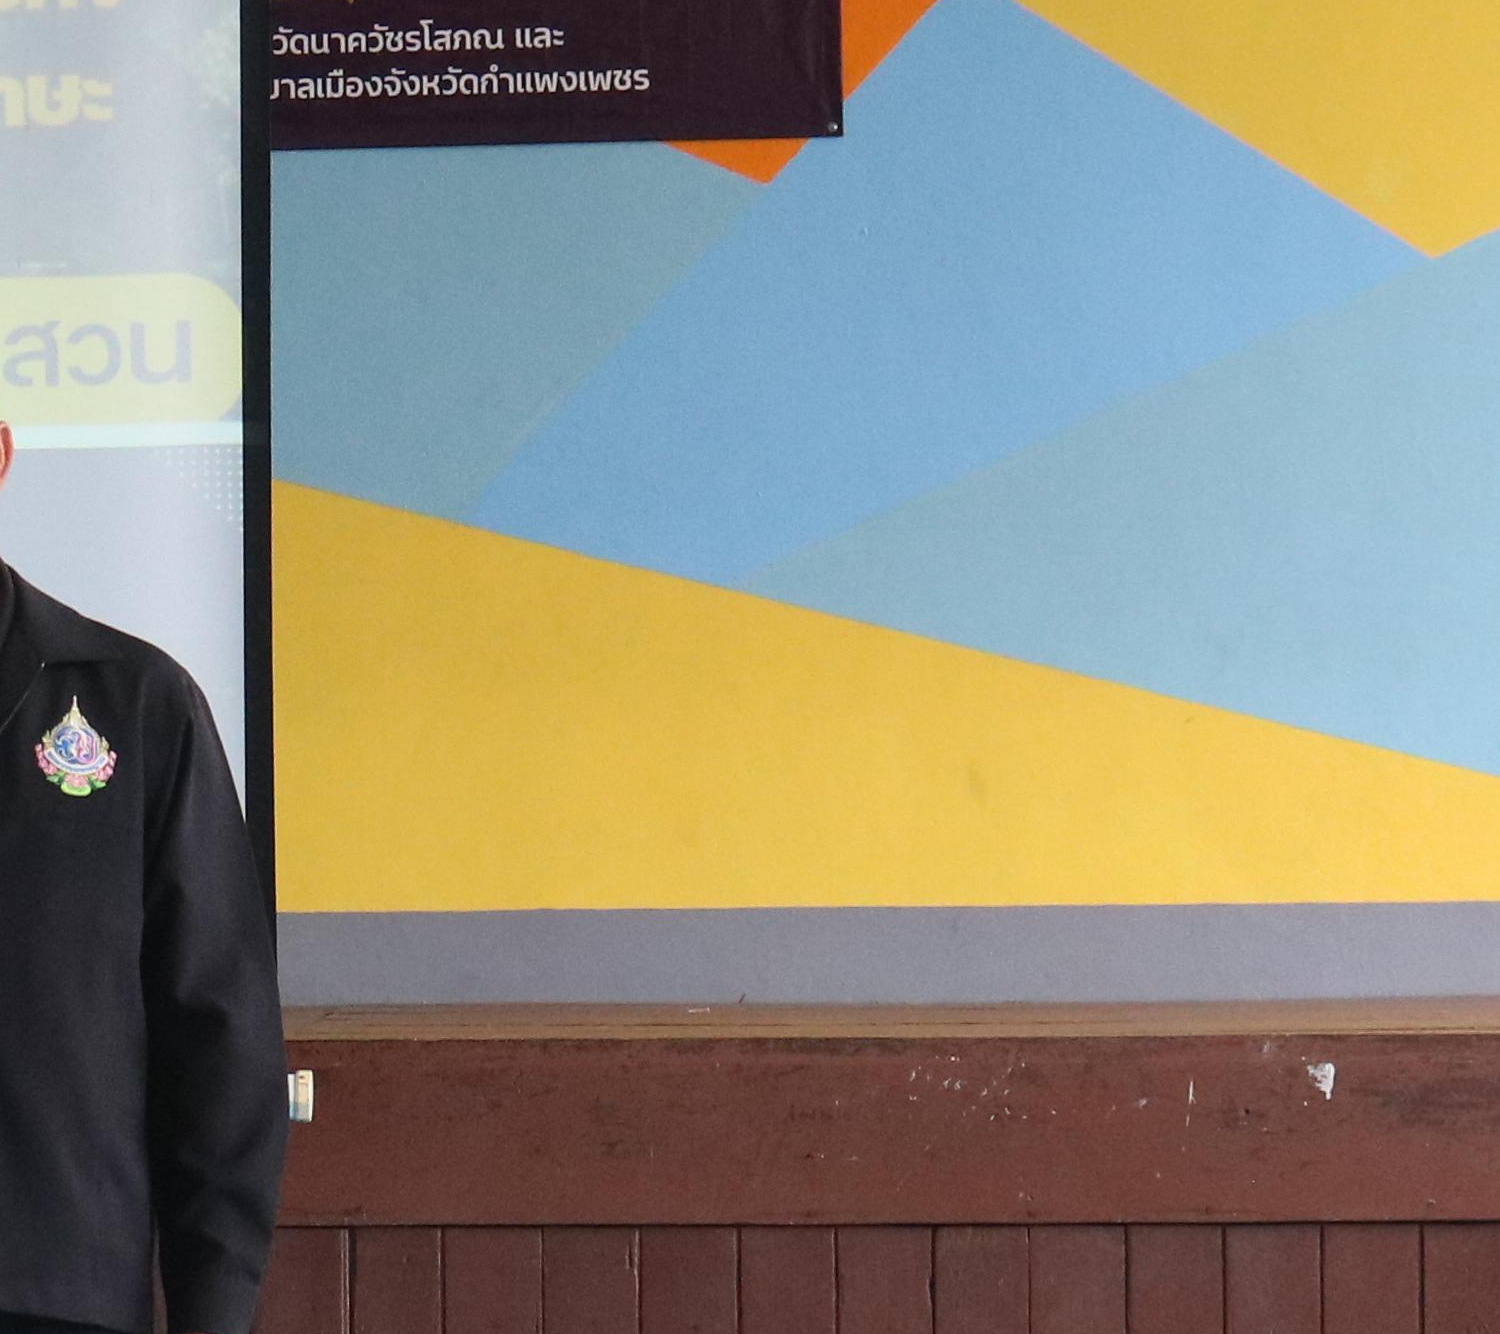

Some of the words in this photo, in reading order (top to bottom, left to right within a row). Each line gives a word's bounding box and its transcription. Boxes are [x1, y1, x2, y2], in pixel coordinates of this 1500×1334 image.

[272, 19, 505, 56] วัดนาควัชรโสภณ
[515, 26, 565, 49] และ
